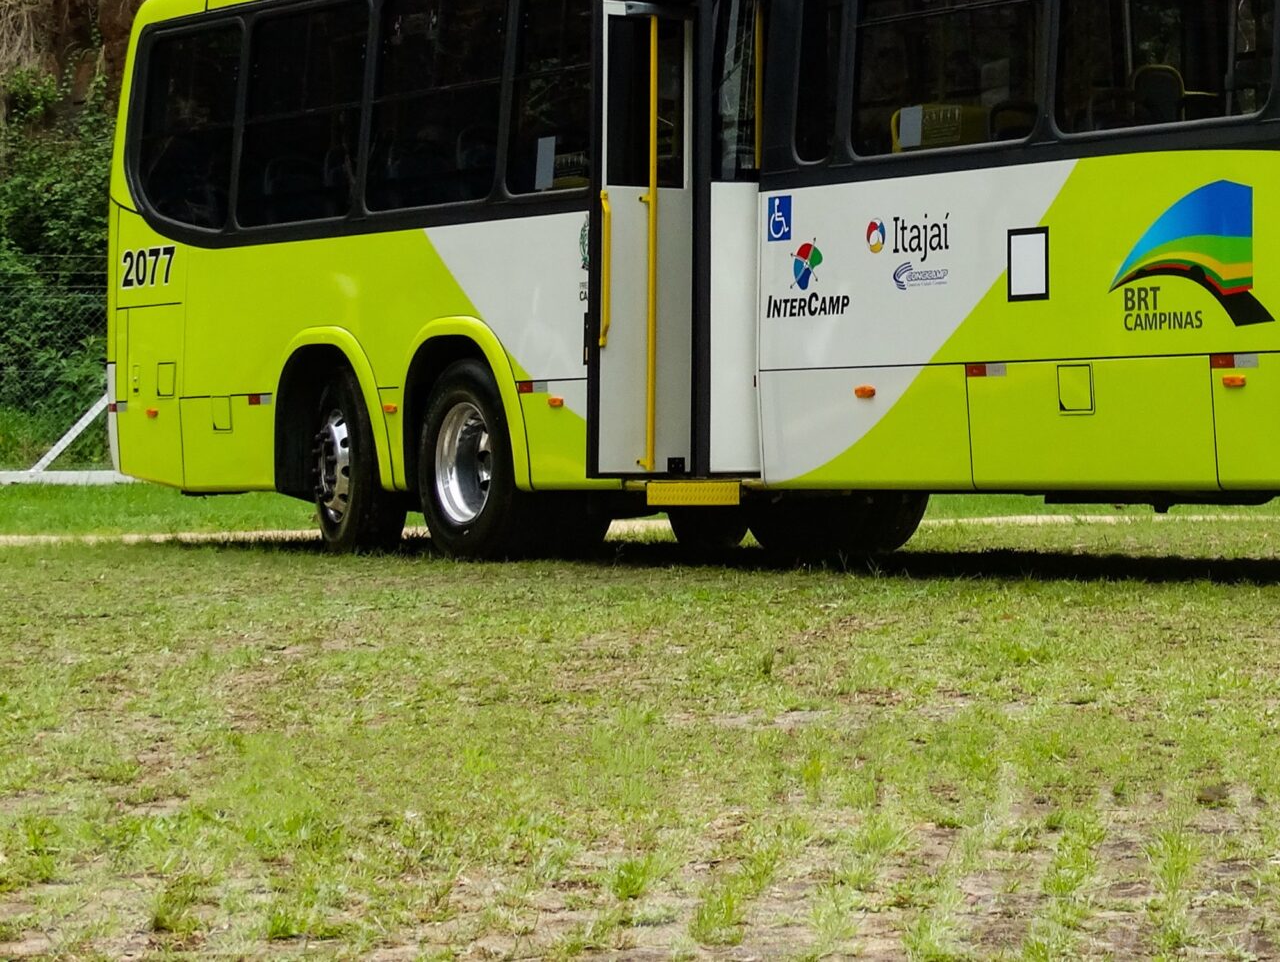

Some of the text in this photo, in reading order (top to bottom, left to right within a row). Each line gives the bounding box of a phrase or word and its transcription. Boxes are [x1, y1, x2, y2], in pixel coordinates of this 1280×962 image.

[893, 212, 949, 262] Itajaí
[122, 246, 176, 288] 2077
[1124, 286, 1160, 311] BRT
[1124, 310, 1203, 331] CAMPINAS
